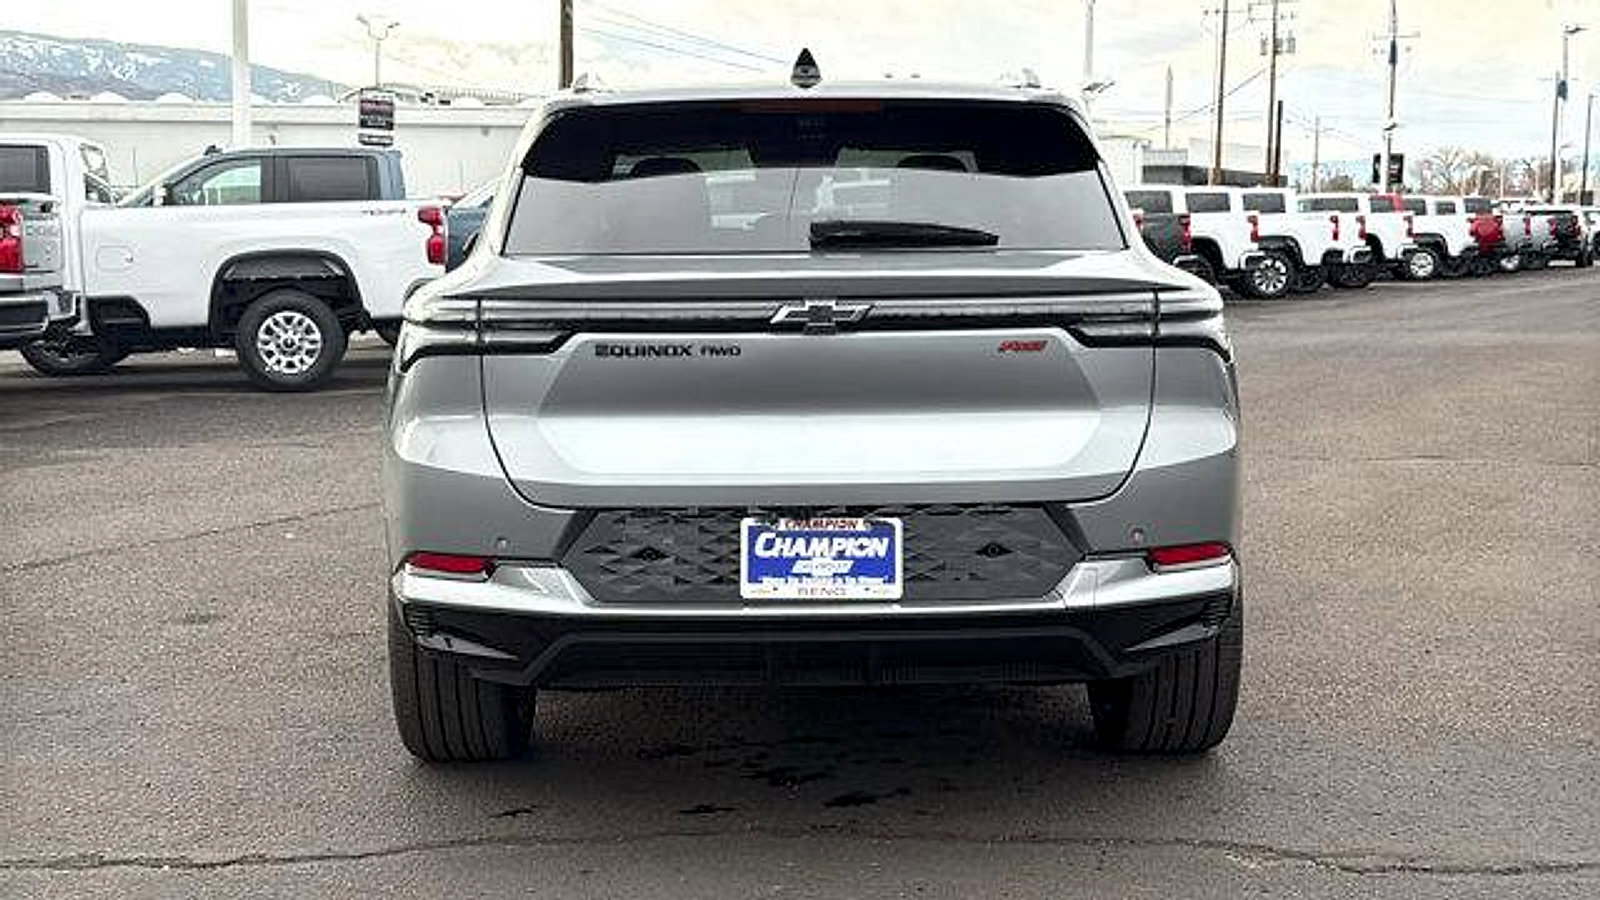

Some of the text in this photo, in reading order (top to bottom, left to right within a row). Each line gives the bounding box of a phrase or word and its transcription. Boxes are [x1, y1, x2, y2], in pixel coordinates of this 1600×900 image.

[595, 344, 692, 357] EQUINOX
[784, 518, 859, 530] CHAMPION
[755, 532, 889, 558] CHAMPION
